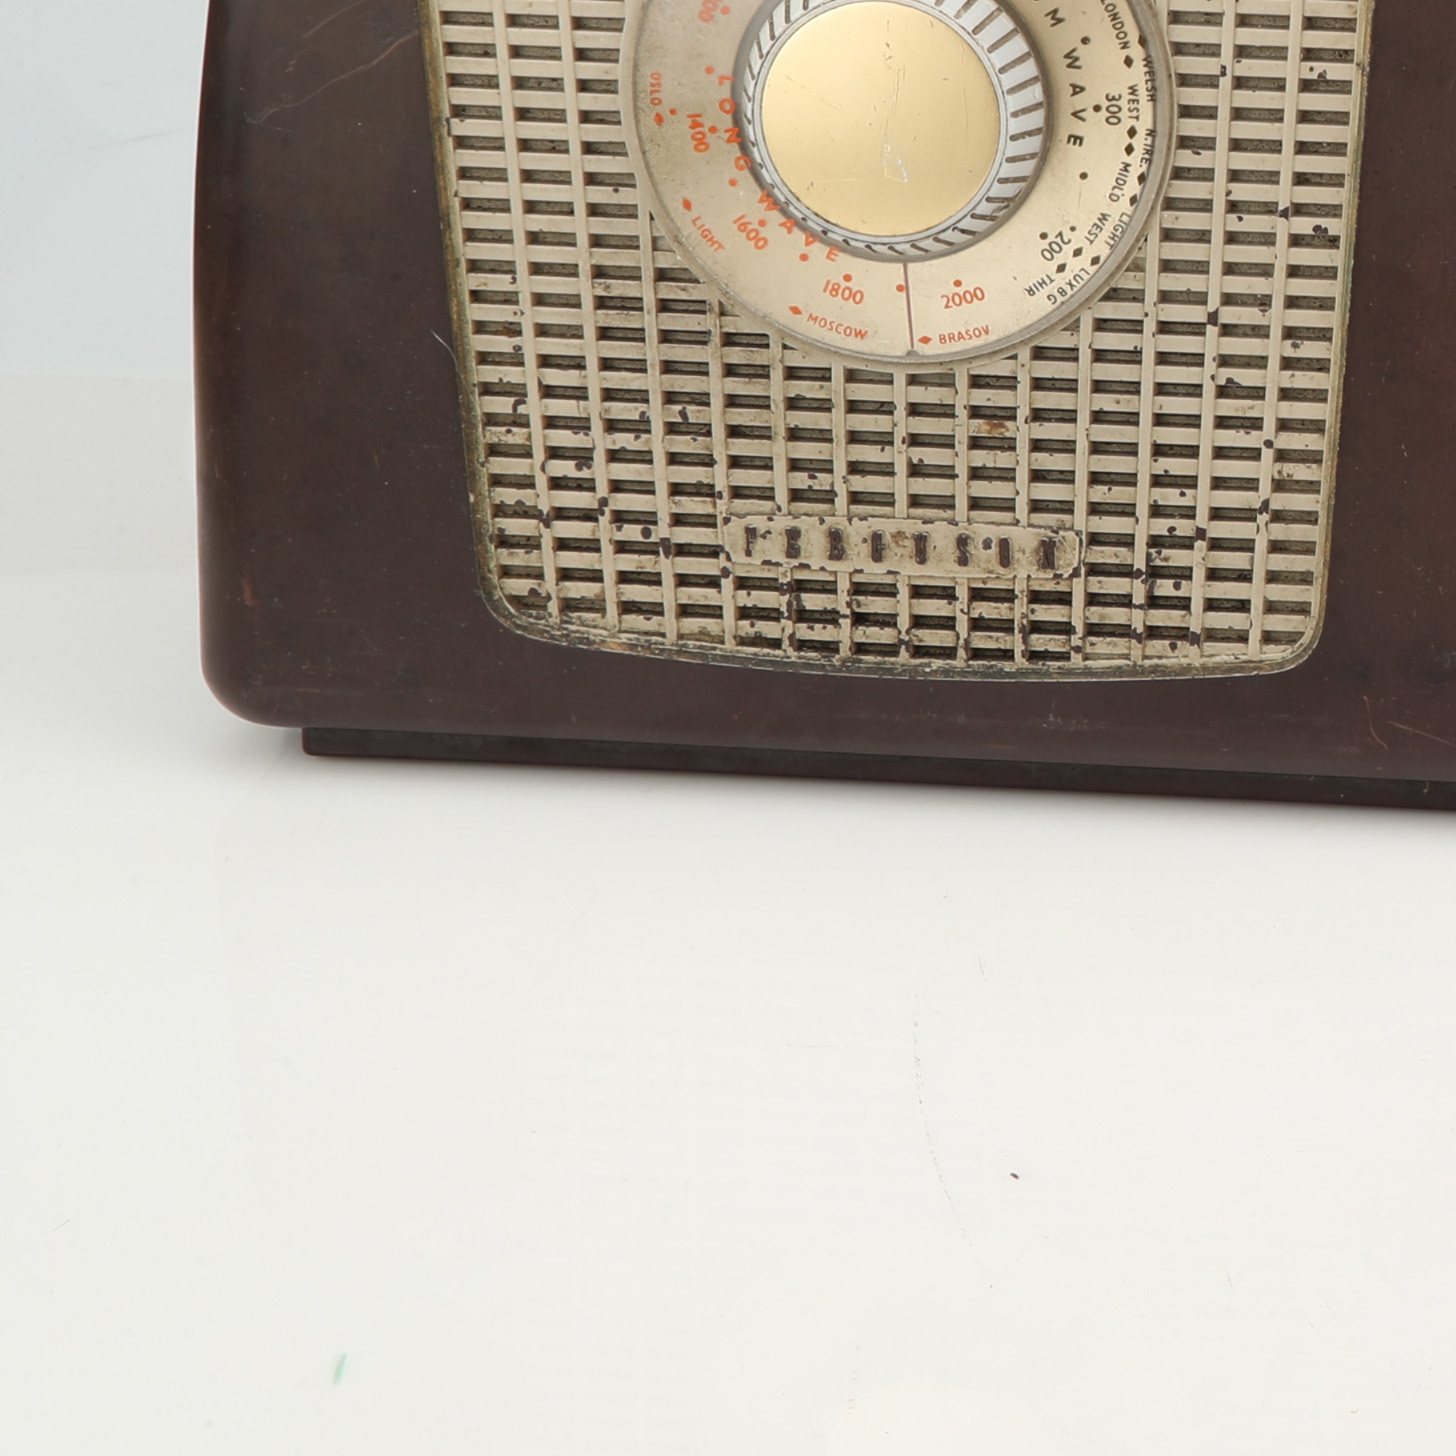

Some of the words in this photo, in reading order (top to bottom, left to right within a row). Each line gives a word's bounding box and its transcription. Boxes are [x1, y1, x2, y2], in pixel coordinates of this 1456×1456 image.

[650, 72, 663, 106] OSLO
[1142, 54, 1157, 103] WELSH
[1063, 47, 1088, 147] WAVE
[1105, 93, 1122, 126] 300
[1127, 83, 1140, 122] WEST
[686, 113, 710, 153] 1400
[718, 75, 752, 171] LONG
[758, 189, 841, 262] WAVE
[692, 216, 725, 253] LIGHT
[732, 214, 768, 250] 1600
[1040, 231, 1072, 262] 200
[1084, 212, 1111, 245] WEST
[1104, 211, 1131, 250] LIGHT
[822, 279, 864, 305] 1800
[940, 286, 985, 309] 2000
[806, 313, 868, 340] MOSCOW
[938, 325, 990, 344] BRASOV
[744, 524, 1058, 570] FERGUSON
